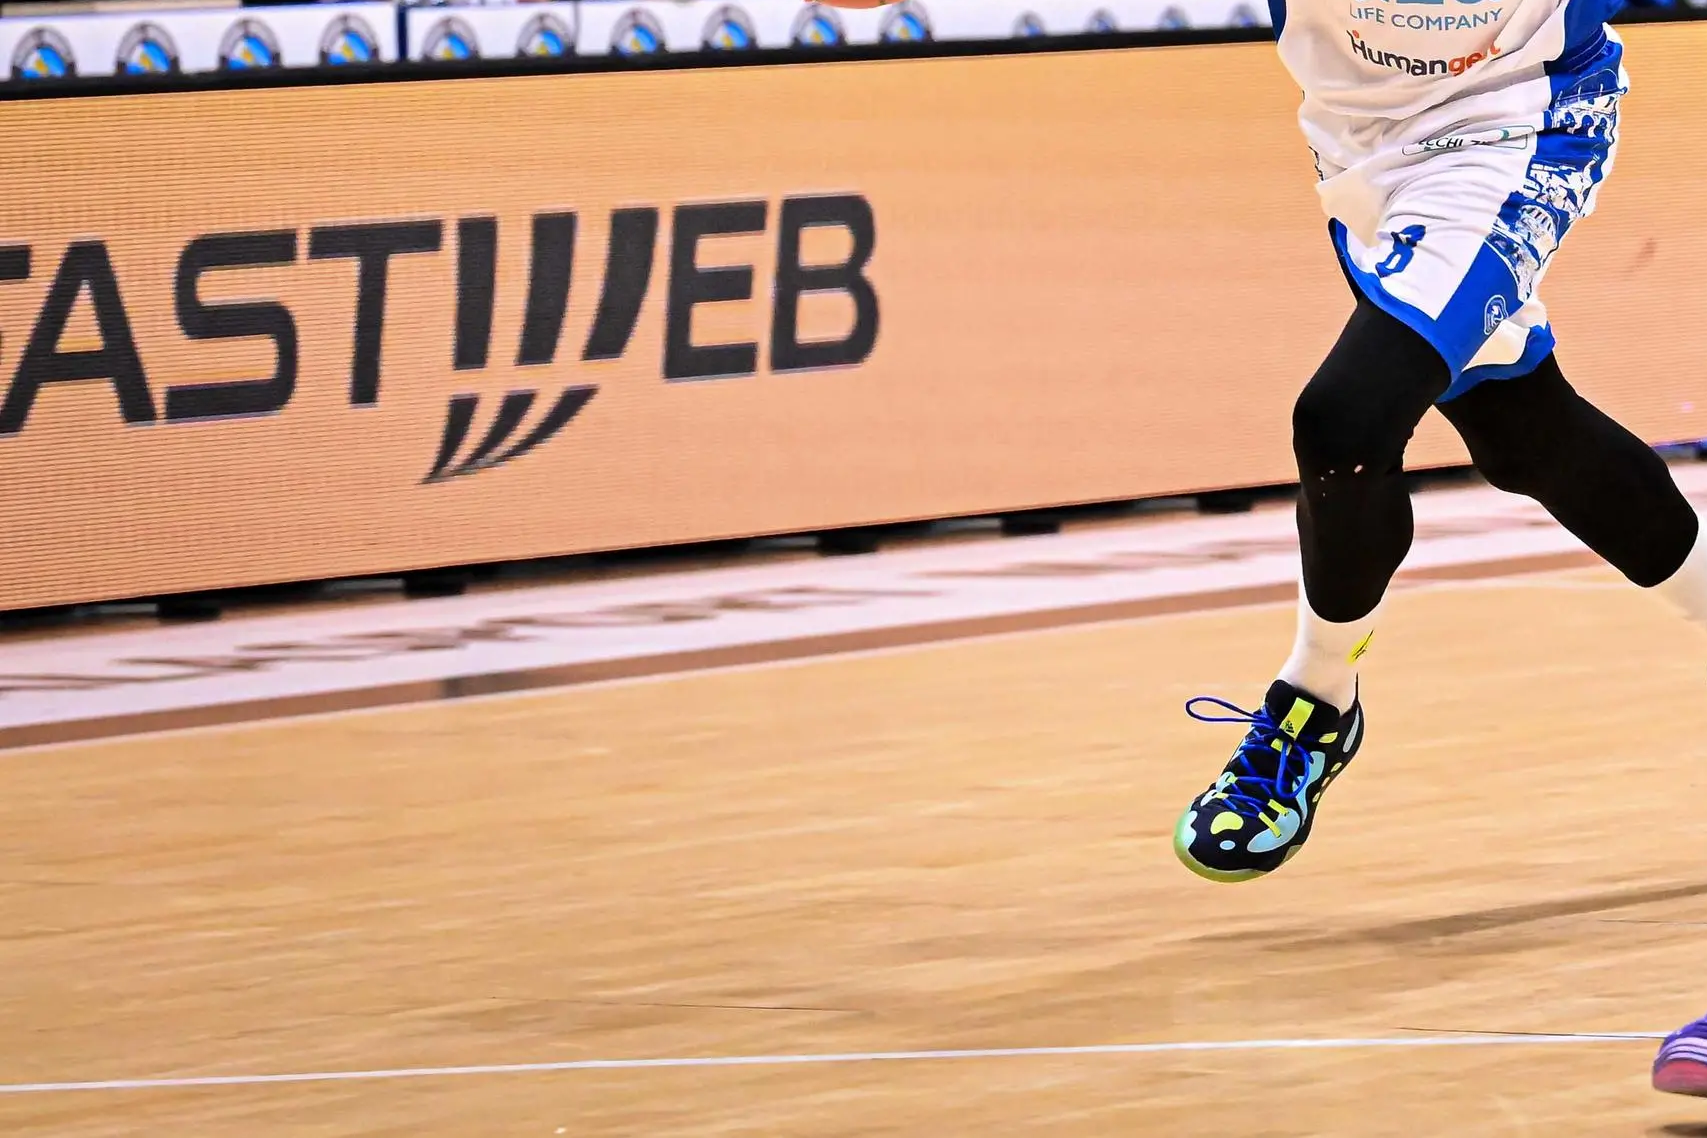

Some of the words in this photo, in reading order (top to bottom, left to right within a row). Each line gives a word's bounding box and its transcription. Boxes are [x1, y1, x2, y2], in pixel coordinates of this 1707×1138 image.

[1349, 4, 1386, 25] LIFE
[1390, 7, 1504, 32] COMPANY
[0, 194, 881, 440] ASTWEB
